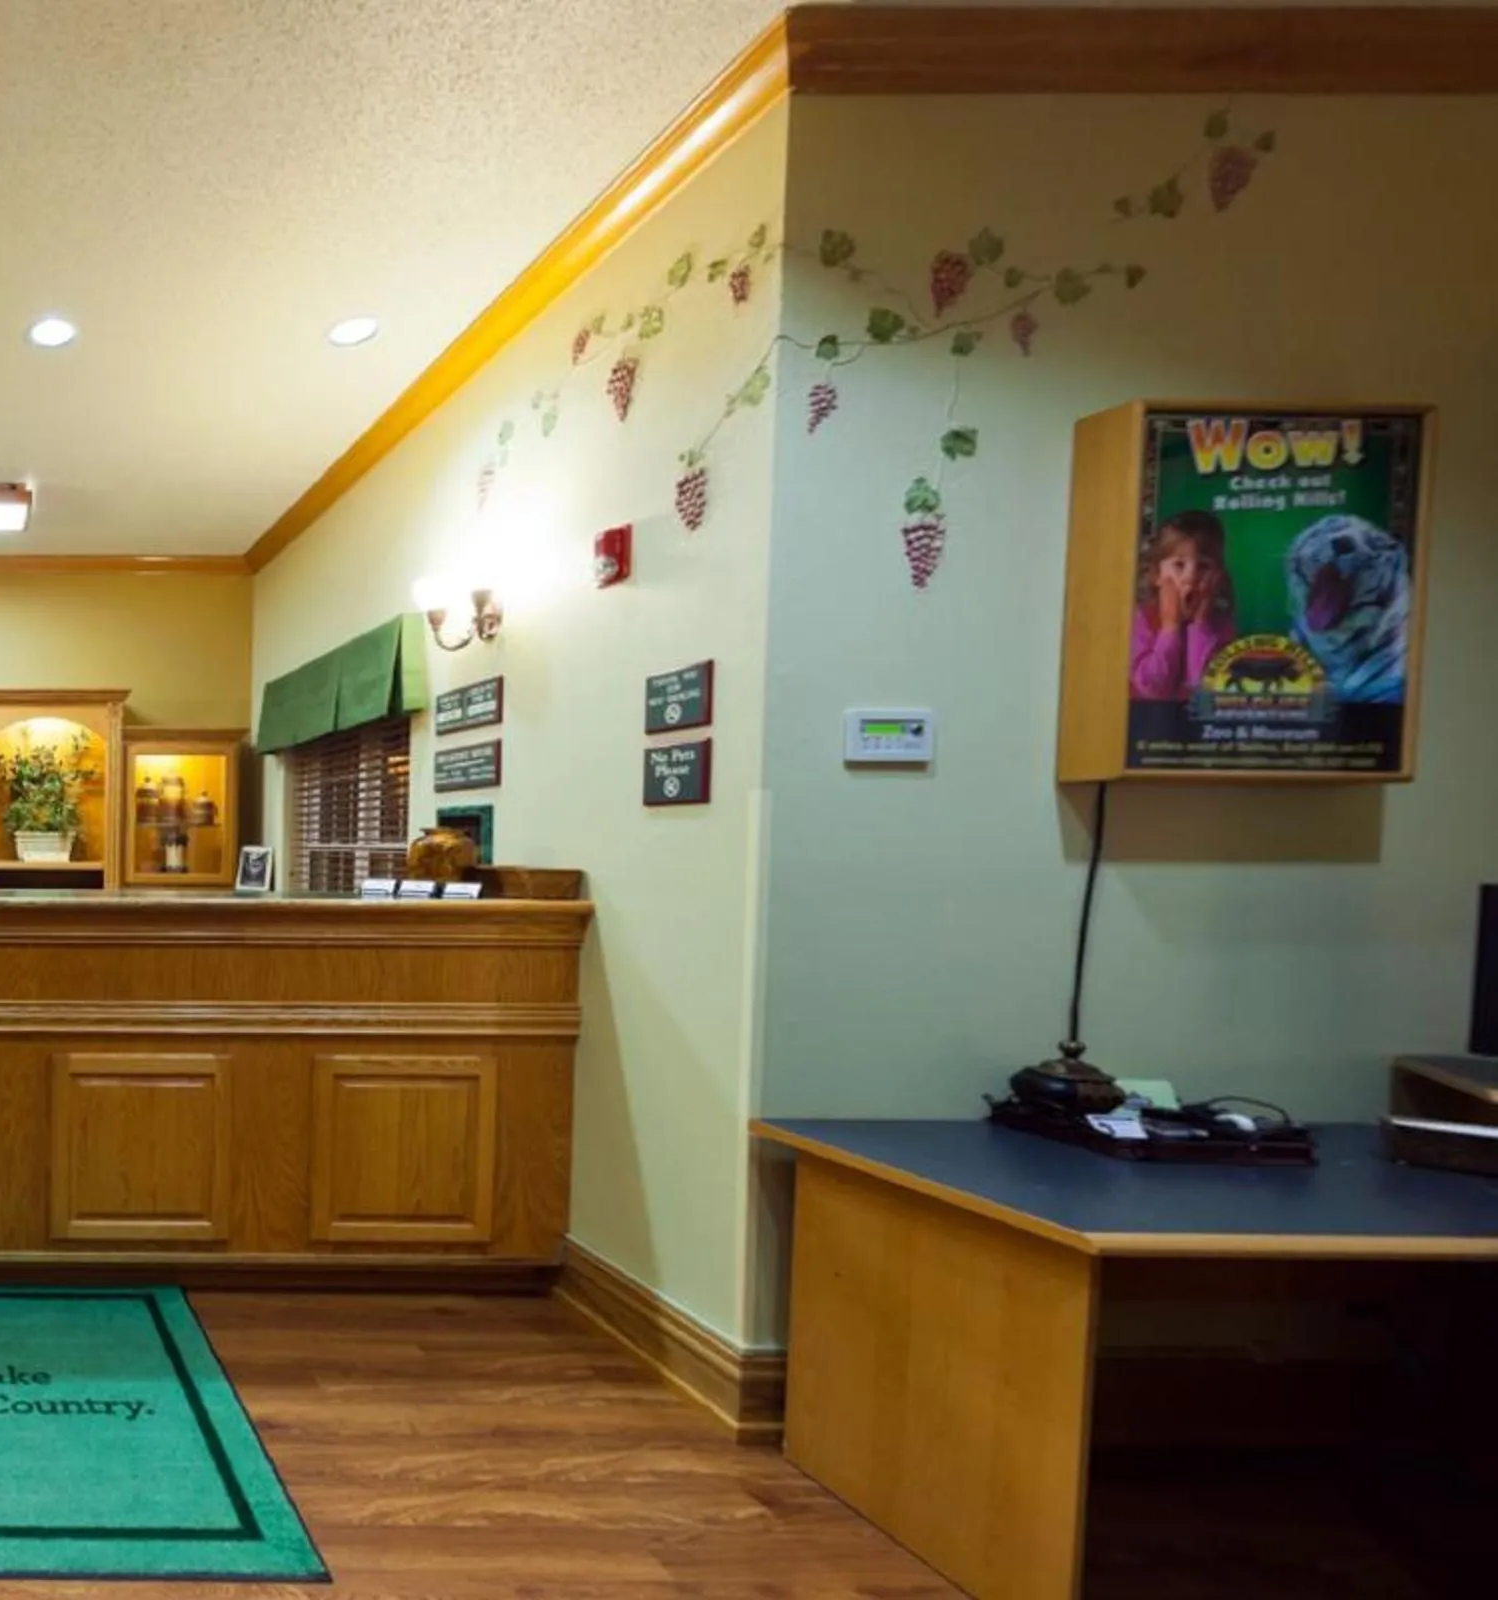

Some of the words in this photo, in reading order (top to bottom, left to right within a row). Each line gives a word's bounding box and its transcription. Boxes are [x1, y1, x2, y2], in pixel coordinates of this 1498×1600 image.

[1188, 419, 1365, 473] Wow!
[1230, 473, 1291, 491] Check
[1298, 474, 1331, 489] out
[1202, 725, 1233, 740] Zoo
[1236, 726, 1248, 739] &
[651, 751, 668, 765] No
[672, 748, 695, 762] Pets
